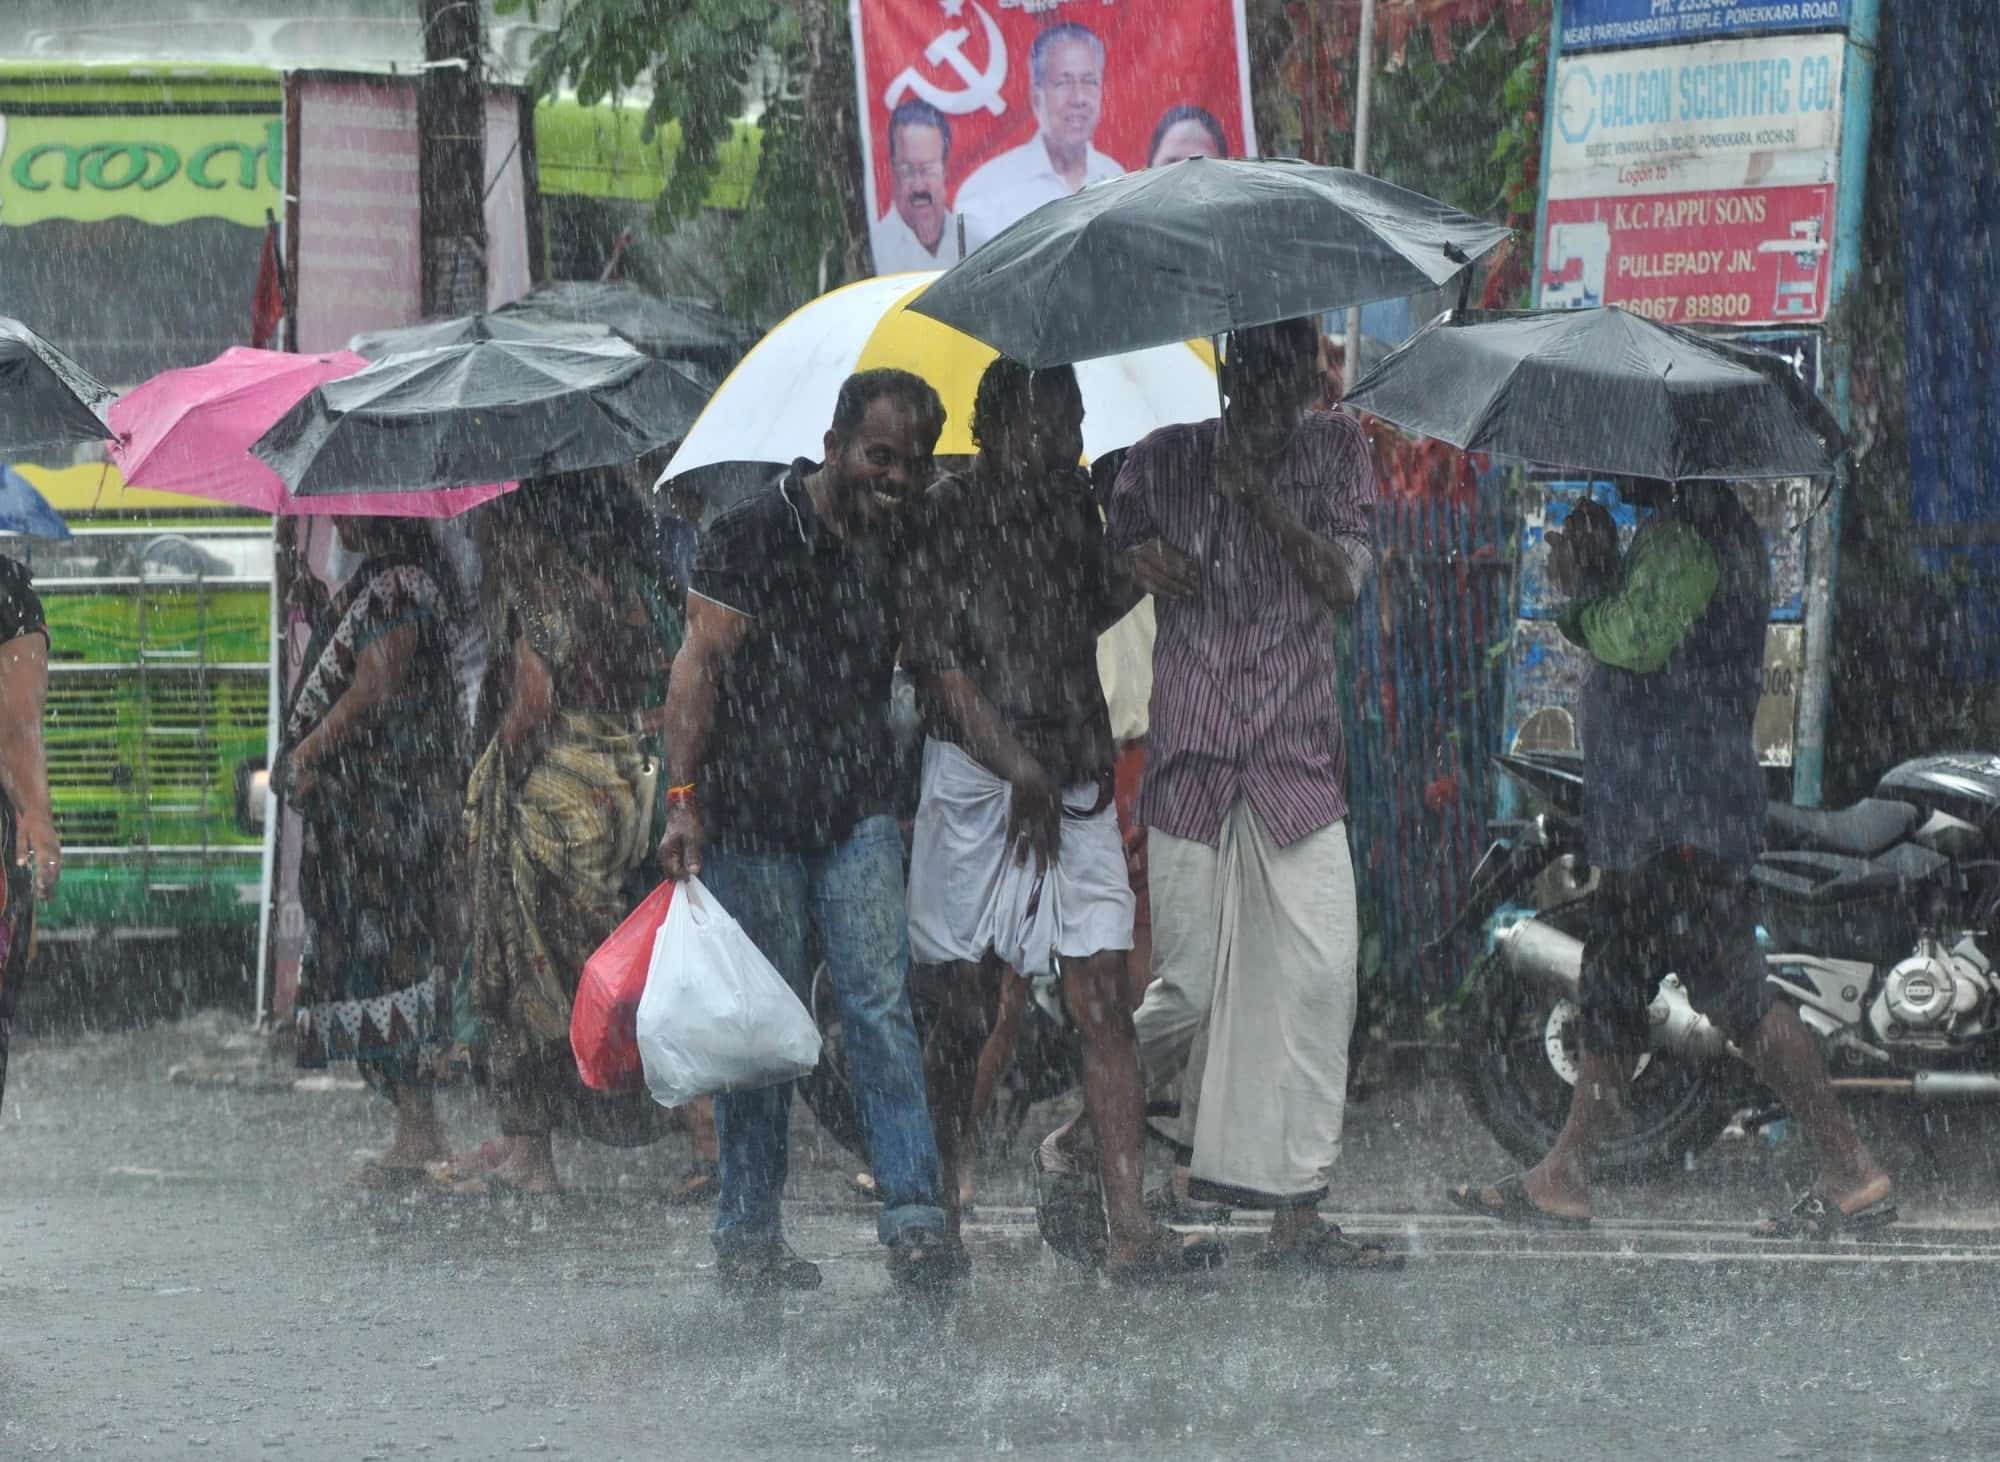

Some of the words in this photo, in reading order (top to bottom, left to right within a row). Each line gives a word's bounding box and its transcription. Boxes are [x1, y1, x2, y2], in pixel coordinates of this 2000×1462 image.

[1563, 26, 1592, 44] NEAR
[1725, 5, 1799, 26] PONEKKARA
[1600, 66, 1672, 128] CALGON
[1679, 56, 1791, 119] SCIENTIFIC
[1614, 201, 1649, 230] K.C.
[1653, 198, 1712, 229] PAPPU
[1715, 195, 1767, 225] SONS
[1618, 251, 1723, 278] PULLEPADY
[1727, 249, 1757, 273] JN.
[1685, 293, 1751, 318] 88800
